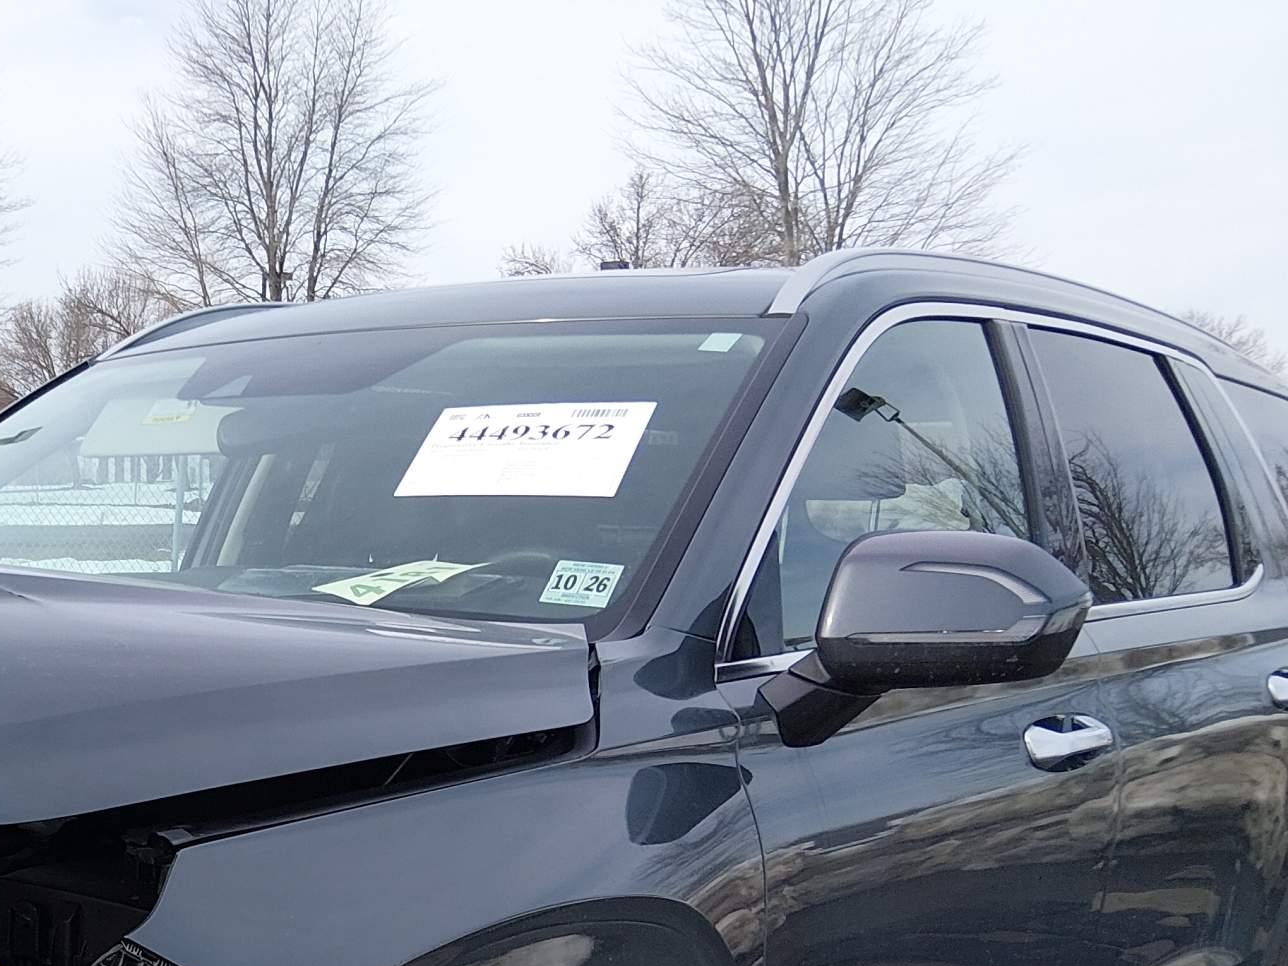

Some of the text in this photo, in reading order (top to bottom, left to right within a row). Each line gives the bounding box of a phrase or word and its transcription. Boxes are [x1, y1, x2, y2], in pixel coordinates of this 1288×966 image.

[448, 423, 616, 442] 44493672
[551, 574, 611, 593] 10 26
